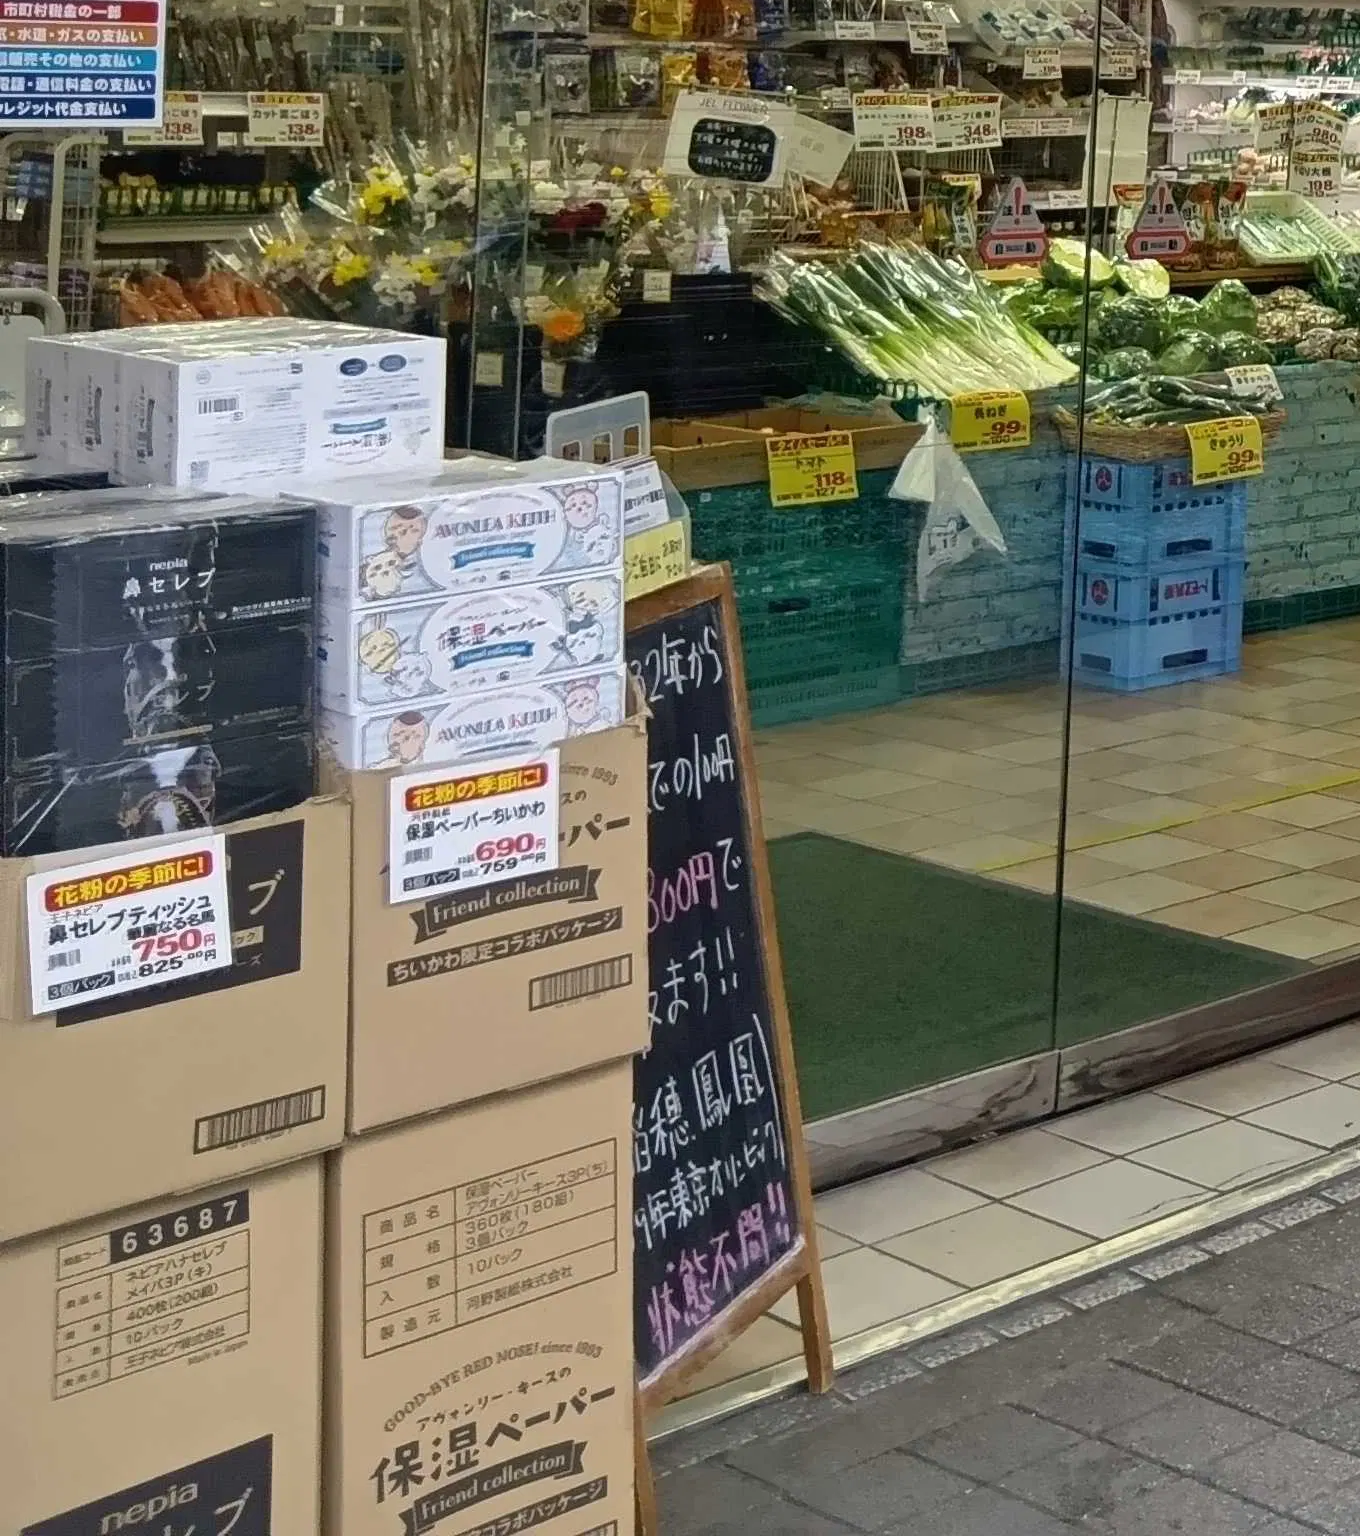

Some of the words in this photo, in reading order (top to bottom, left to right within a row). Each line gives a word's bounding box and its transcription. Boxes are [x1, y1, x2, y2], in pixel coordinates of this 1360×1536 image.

[3, 3, 122, 20] 市町村税金の一部
[0, 101, 127, 120] レジット代金支払い
[287, 123, 314, 134] 138
[963, 125, 992, 138] 348
[990, 419, 1021, 436] 99
[1208, 433, 1245, 452] きゅうり
[1227, 449, 1254, 464] 99
[816, 471, 846, 488] 118
[434, 513, 504, 541] AVONLEA
[508, 509, 557, 530] KEITH
[149, 557, 188, 572] nepia
[123, 567, 217, 600] 鼻セレブ
[435, 711, 506, 744] AVONLEA
[509, 706, 559, 730] KEITH
[412, 767, 542, 808] 花粉の季節に!
[405, 800, 546, 842] 保湿ペーパーちいかわ
[475, 832, 546, 863] 690円
[55, 856, 206, 908] 花粉の季節に!
[404, 869, 460, 892] 3個パック
[432, 890, 492, 925] Friend
[495, 875, 581, 906] collection
[48, 894, 213, 946] 鼻セレブティッシュ
[126, 909, 216, 941] 華麗なる名馬
[132, 928, 216, 963] 750円
[392, 909, 620, 983] ちいかわ限定コラボパッケージ
[48, 971, 114, 1000] 3個パック
[379, 1204, 441, 1236] 商品名
[465, 1169, 540, 1201] 保湿ペーパー
[121, 1198, 239, 1254] 63687
[379, 1238, 441, 1270] 規格
[465, 1189, 575, 1237] 360枚(180組)
[464, 1219, 529, 1251] 3個パック
[379, 1273, 441, 1307] 入数
[467, 1246, 524, 1276] 10パック
[379, 1307, 442, 1341] 製造元
[465, 1264, 574, 1312] 河野製紙株式会社
[383, 1368, 461, 1434] GOOD-BYE
[462, 1354, 494, 1377] RED
[495, 1341, 540, 1365] NOSE!
[540, 1340, 574, 1355] since
[368, 1385, 616, 1505] 保湿ペーパー
[419, 1480, 479, 1522] Friend
[482, 1450, 567, 1494] collection
[99, 1481, 200, 1535] nepia
